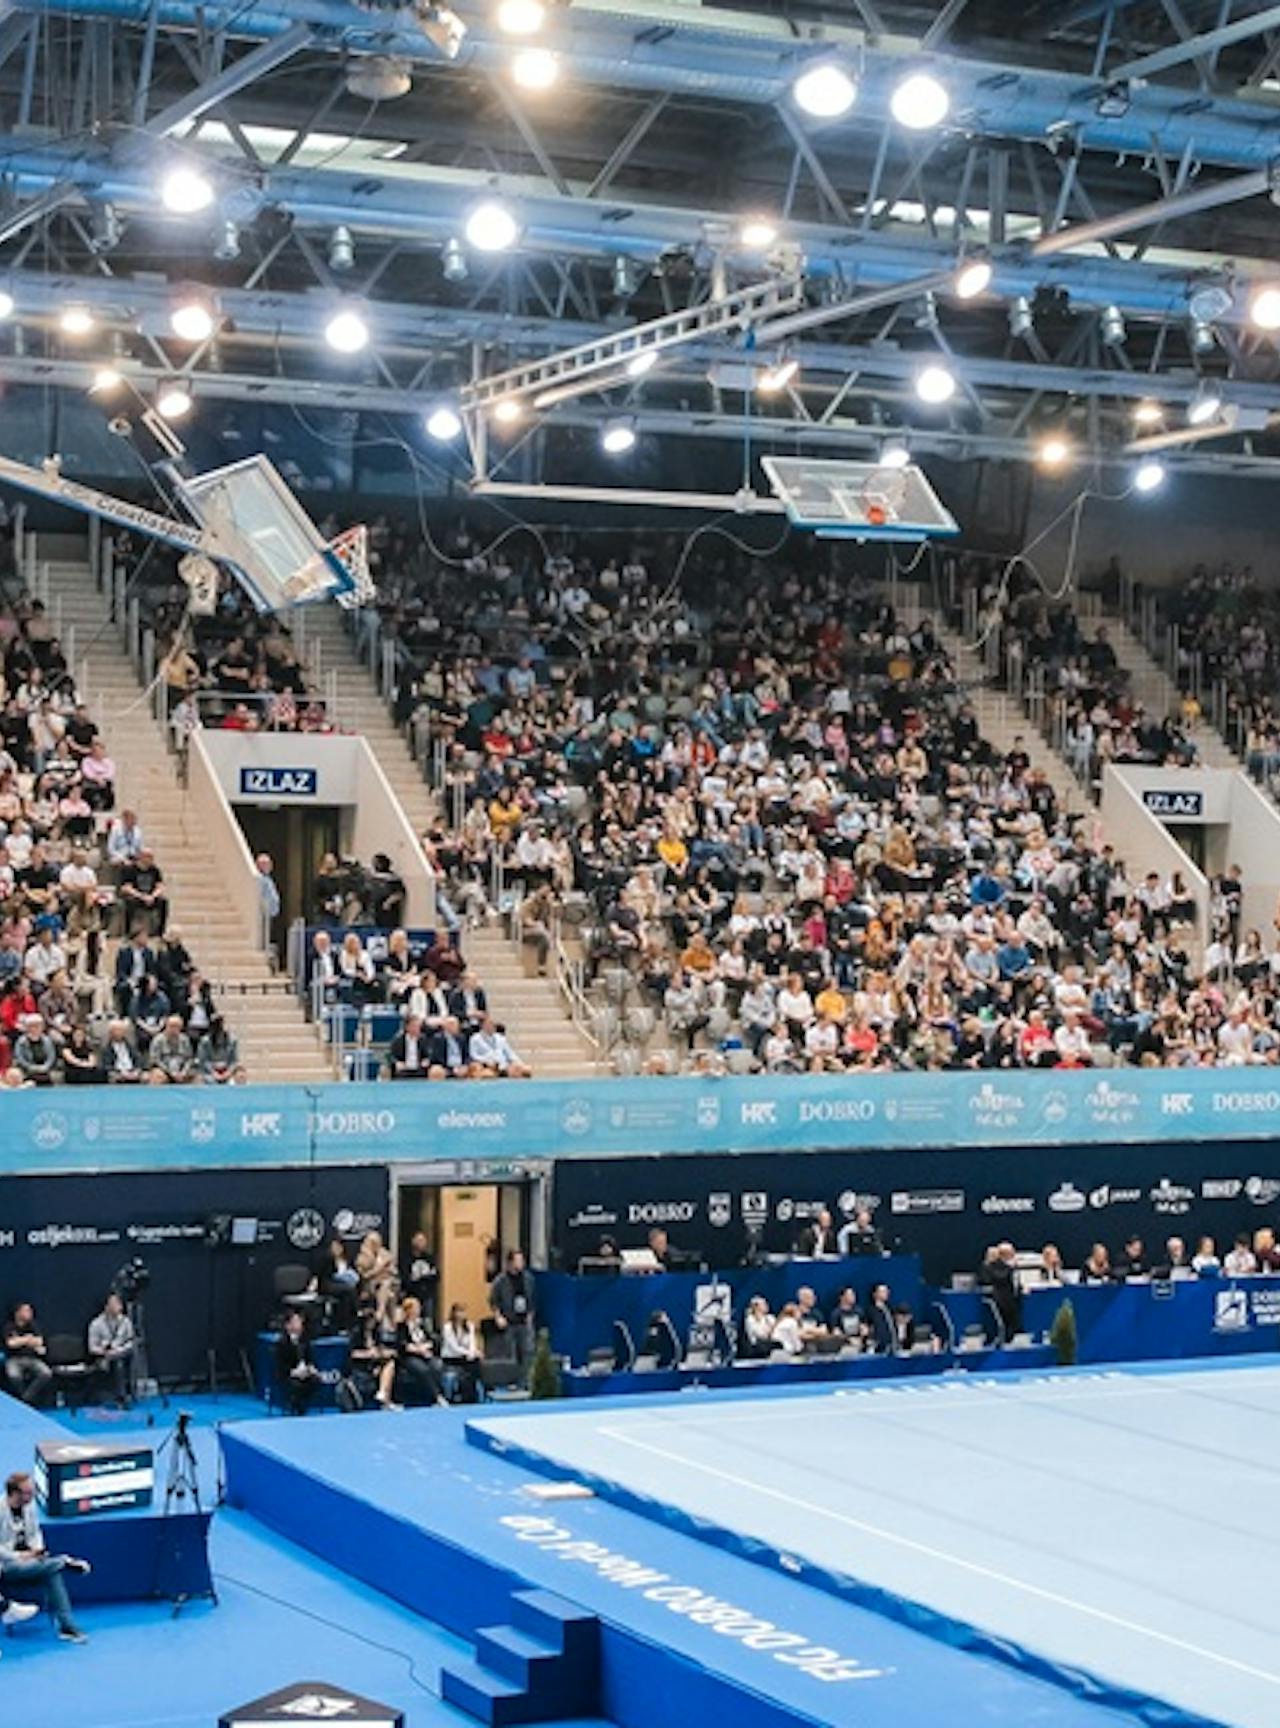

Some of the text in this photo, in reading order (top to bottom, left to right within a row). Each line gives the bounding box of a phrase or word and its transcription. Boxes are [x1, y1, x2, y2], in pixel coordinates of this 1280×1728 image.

[245, 770, 311, 792] IZLAZ
[1147, 794, 1199, 814] IZLAZ
[799, 1100, 875, 1121] DOBRO
[1212, 1091, 1280, 1112] DOBRO
[307, 1110, 395, 1136] DOBRO
[628, 1202, 694, 1225] DOBRO
[643, 1584, 809, 1652] DOBRO
